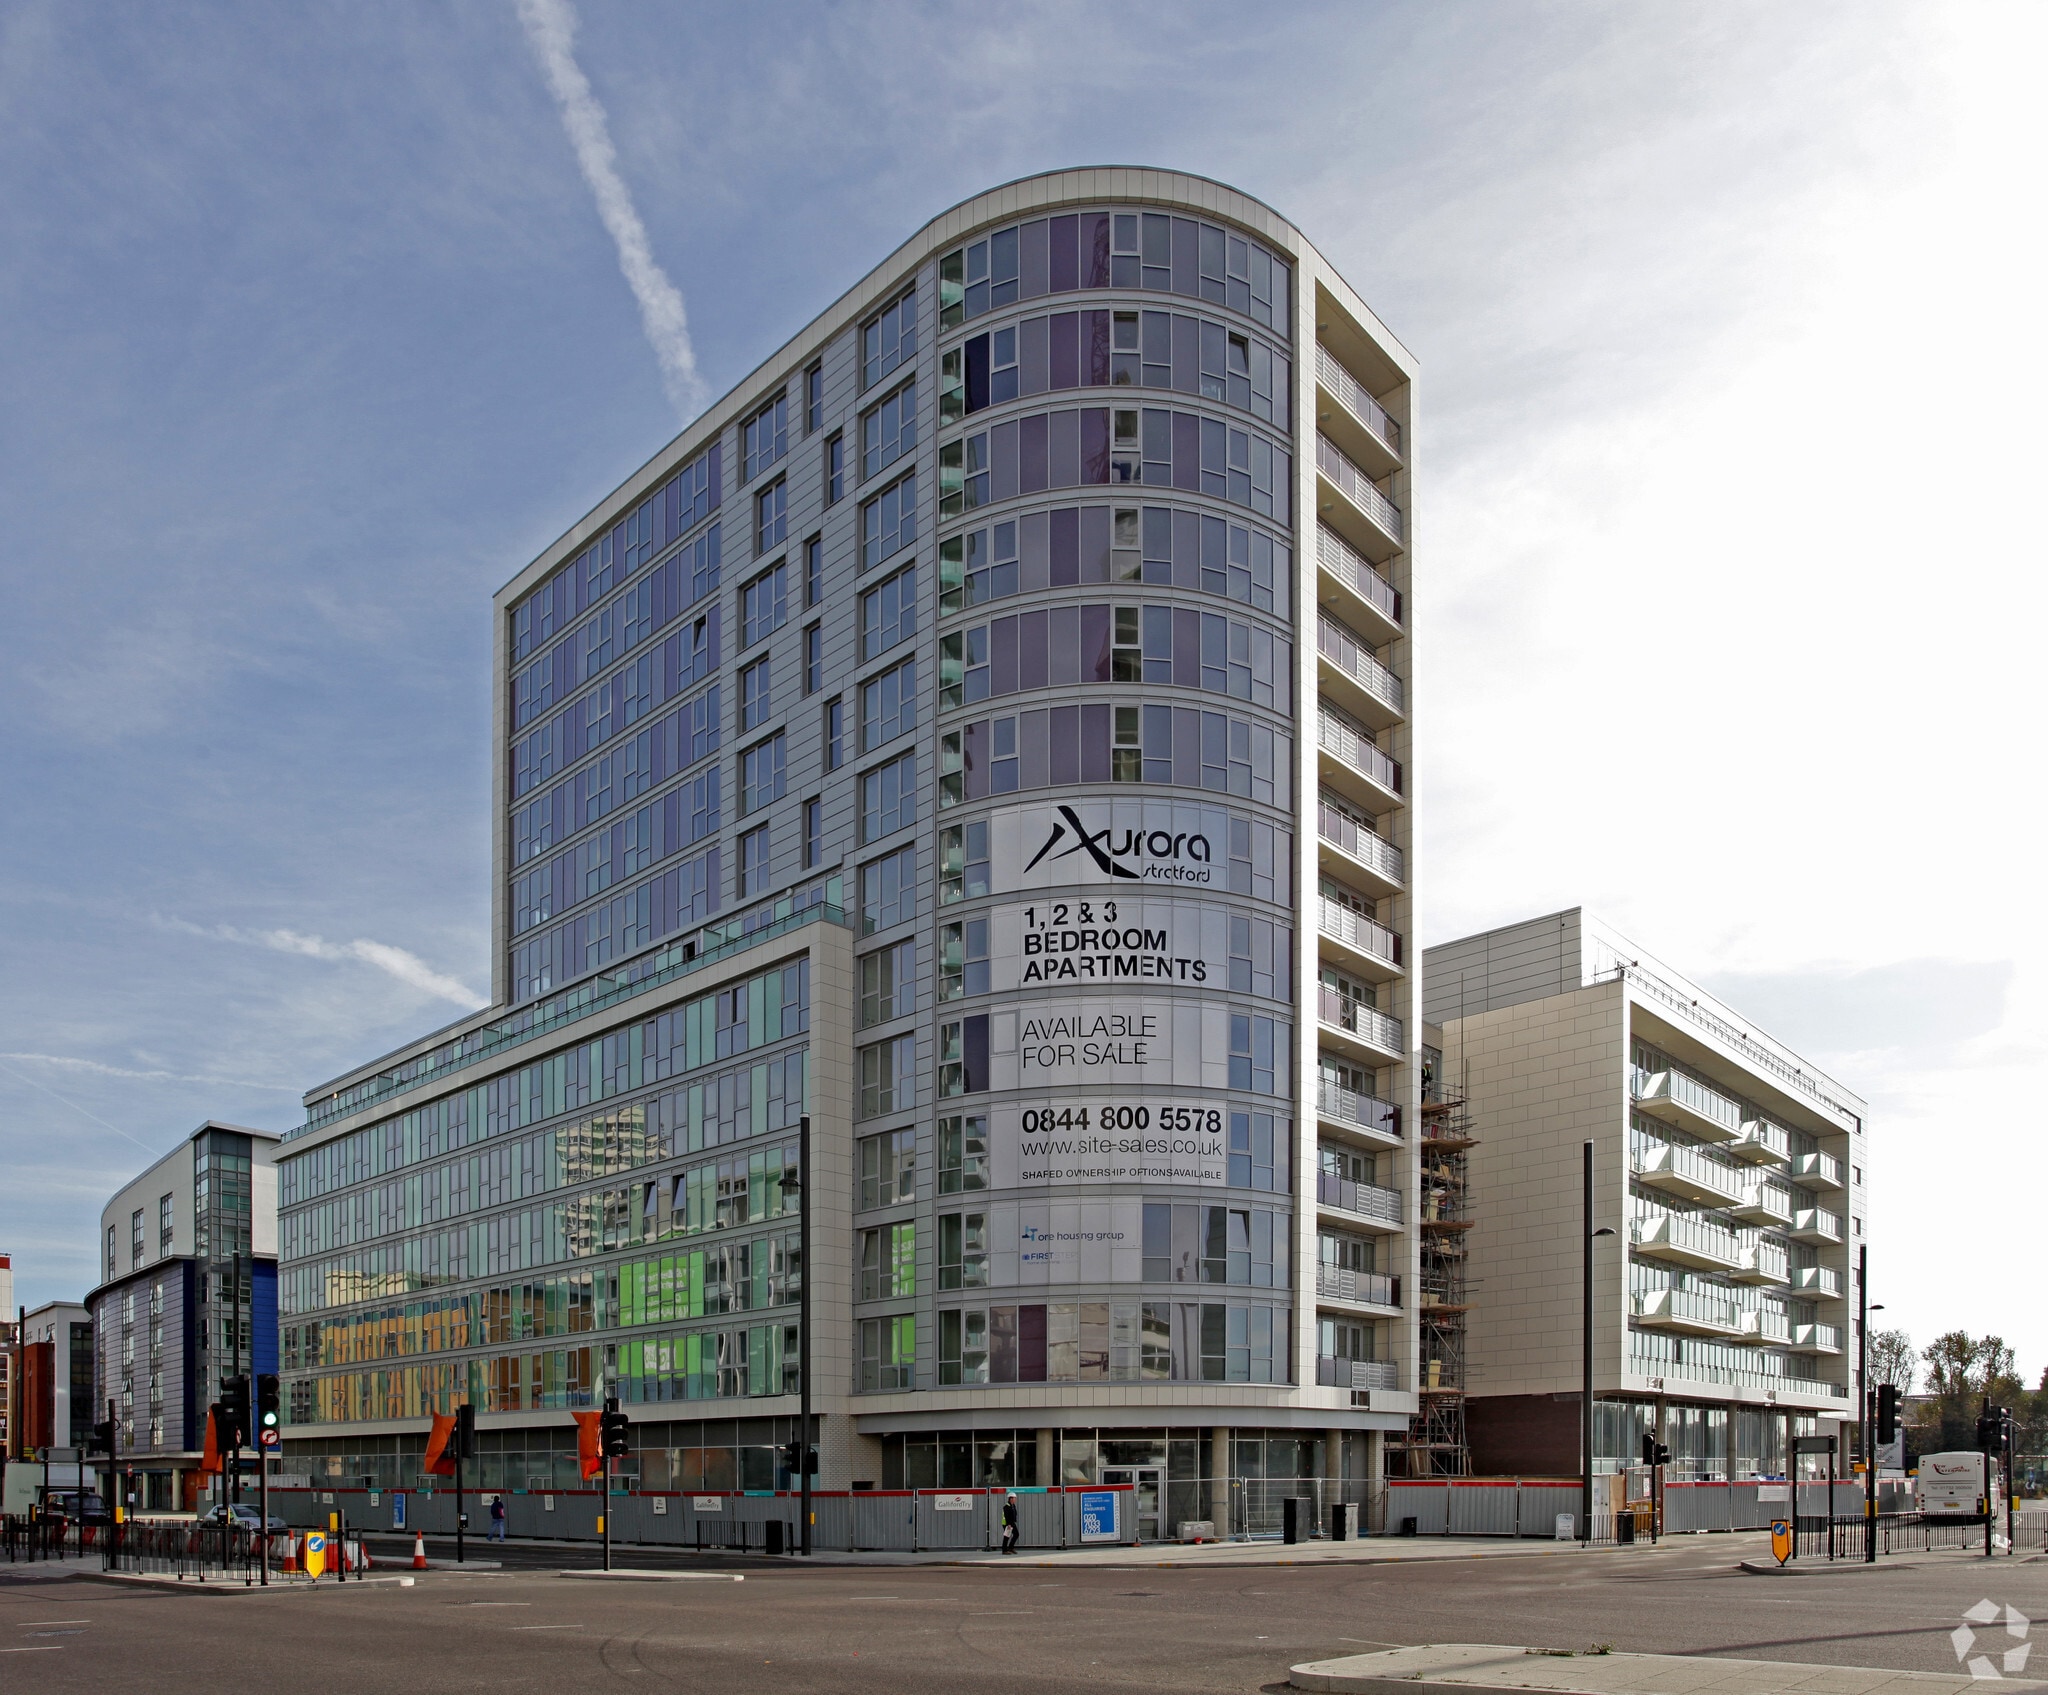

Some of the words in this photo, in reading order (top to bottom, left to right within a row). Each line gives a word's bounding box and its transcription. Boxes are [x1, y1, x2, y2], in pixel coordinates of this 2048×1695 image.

[1023, 805, 1211, 880] Aurora
[1143, 864, 1211, 883] stratford
[1053, 903, 1069, 925] 2
[1078, 902, 1094, 923] &
[1104, 902, 1118, 923] 3
[1024, 928, 1167, 955] BEDROOM
[1023, 954, 1207, 982] APARTMENTS
[1022, 1015, 1157, 1042] AVAILABLE
[1023, 1045, 1075, 1068] FOR
[1083, 1042, 1148, 1066] SALE
[1022, 1108, 1090, 1133] 0844
[1100, 1106, 1150, 1130] 800
[1159, 1107, 1222, 1133] 5578
[1022, 1136, 1223, 1157] www.site-sales.co.uk
[1056, 1231, 1094, 1241] housng
